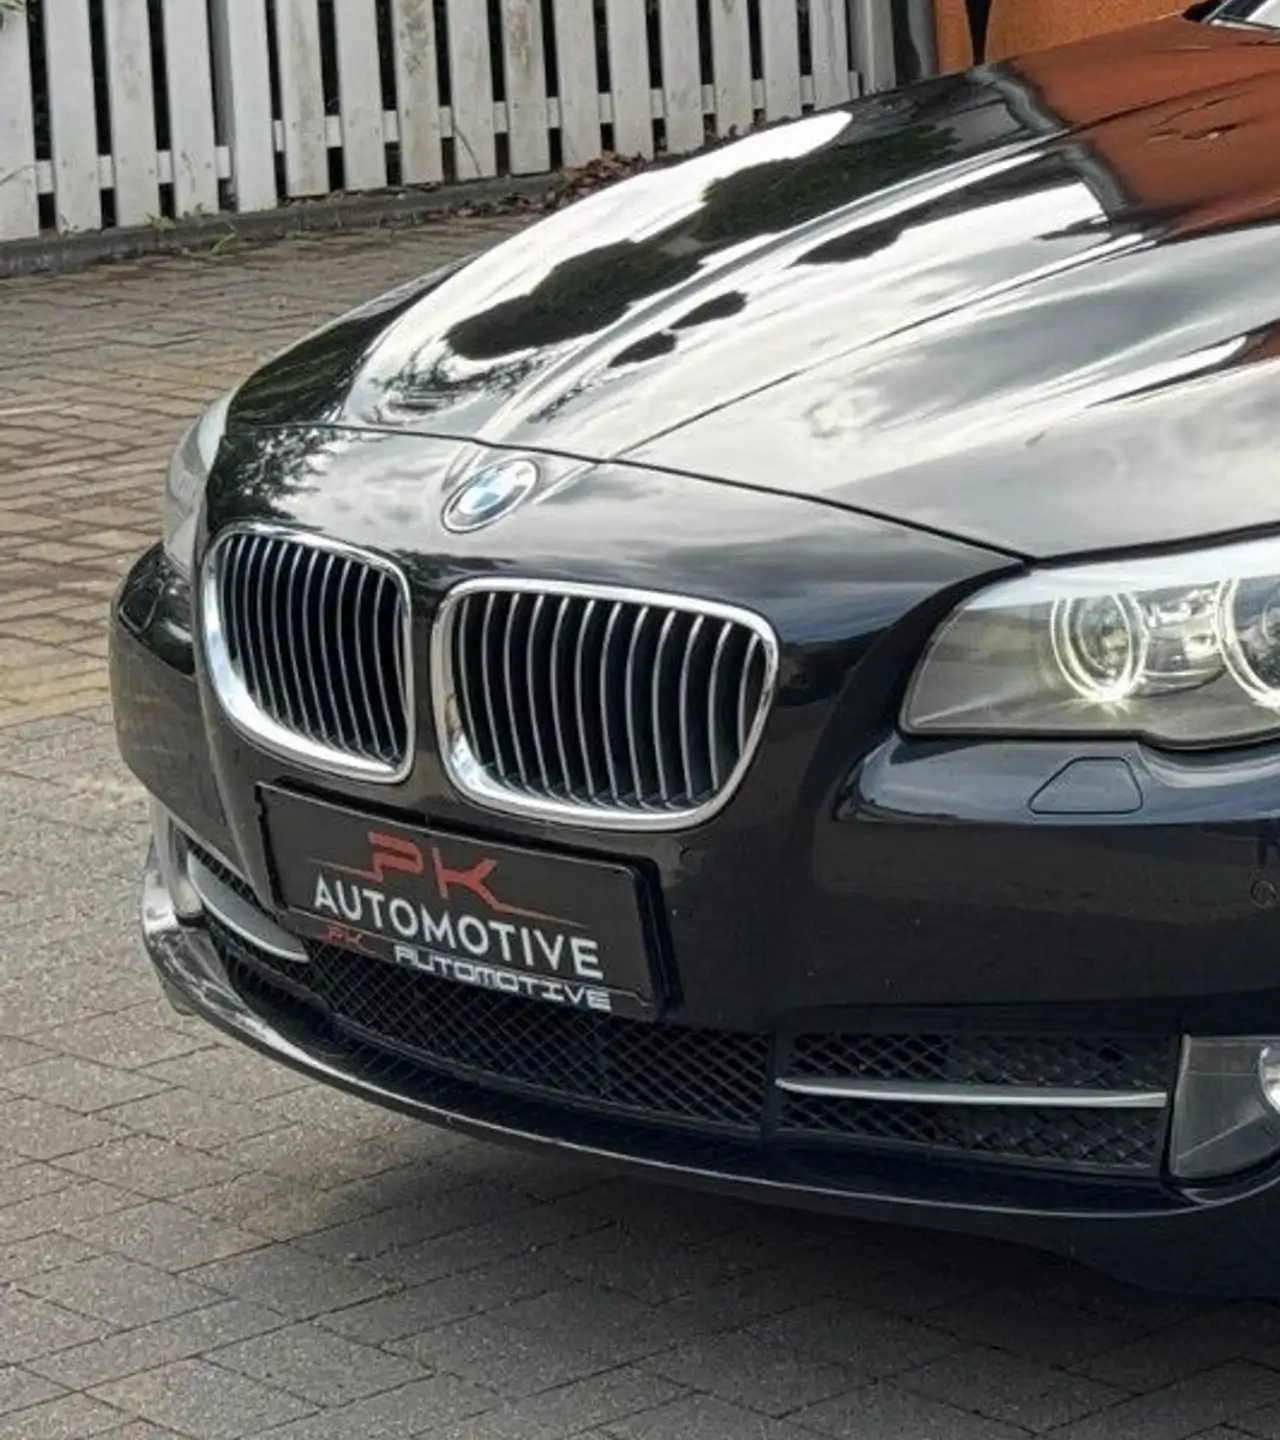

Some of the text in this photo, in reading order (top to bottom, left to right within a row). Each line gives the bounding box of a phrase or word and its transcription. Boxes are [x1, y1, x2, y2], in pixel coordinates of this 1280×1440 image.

[367, 829, 498, 911] PK
[312, 874, 604, 981] AUTOMOTIVE
[394, 944, 612, 1011] AUTOMOTIVE
